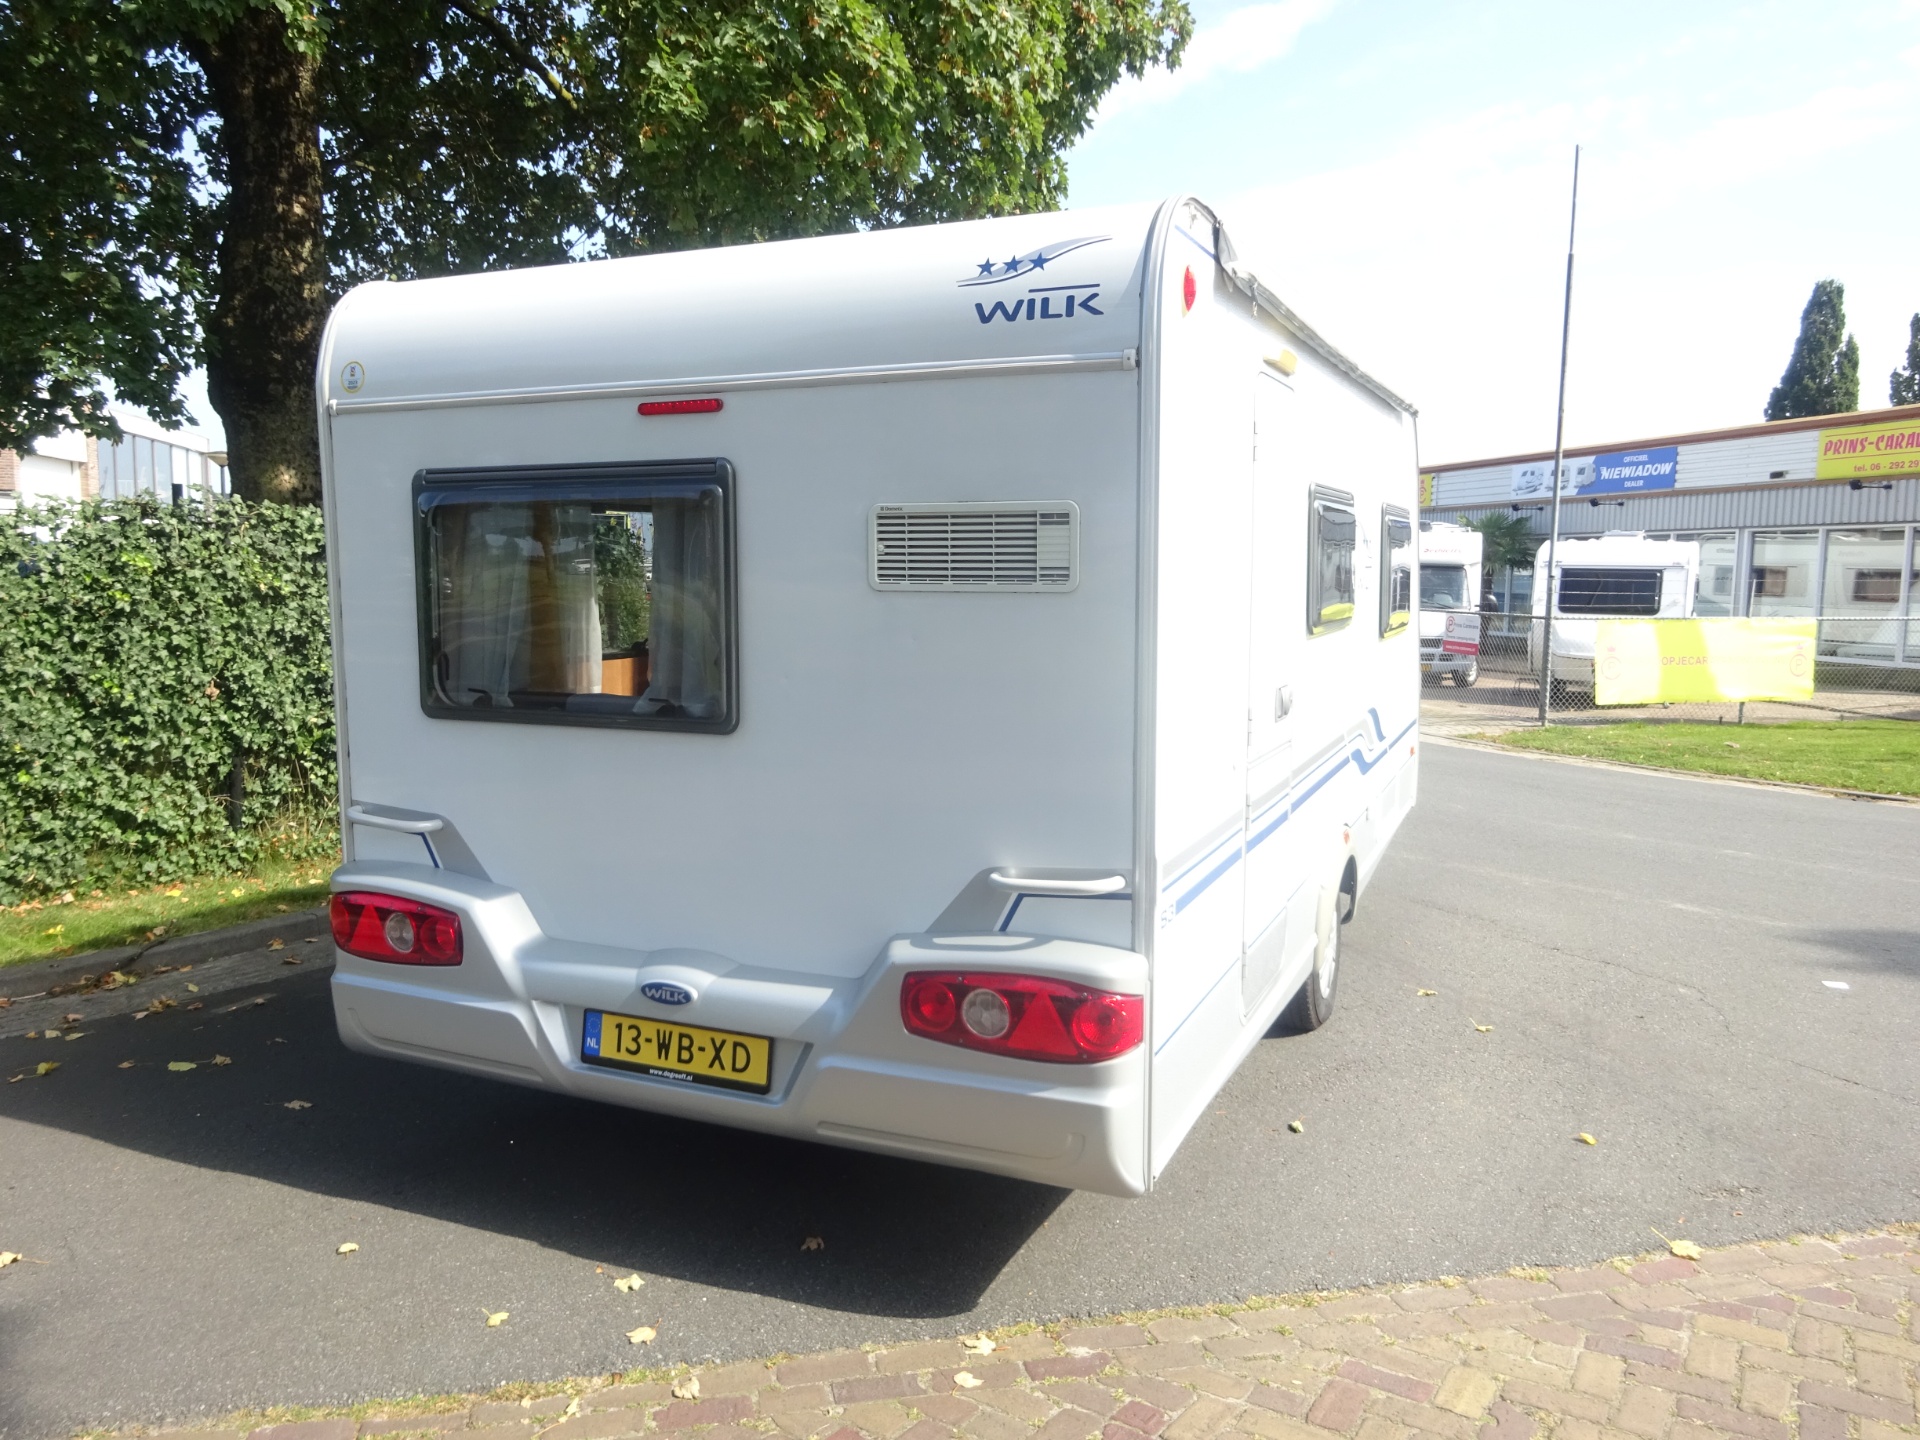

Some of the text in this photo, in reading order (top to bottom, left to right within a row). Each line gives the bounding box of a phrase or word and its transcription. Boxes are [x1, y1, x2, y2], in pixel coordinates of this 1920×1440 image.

[975, 291, 1104, 324] WILK
[1623, 454, 1648, 463] OFFICIEEL
[1854, 464, 1868, 472] tel.
[1870, 463, 1881, 471] 06
[1889, 461, 1905, 470] 292
[1600, 462, 1674, 480] NIEWIADOW
[645, 986, 687, 1003] WILK
[587, 1036, 599, 1049] NL
[614, 1022, 752, 1073] 13-WB-XD
